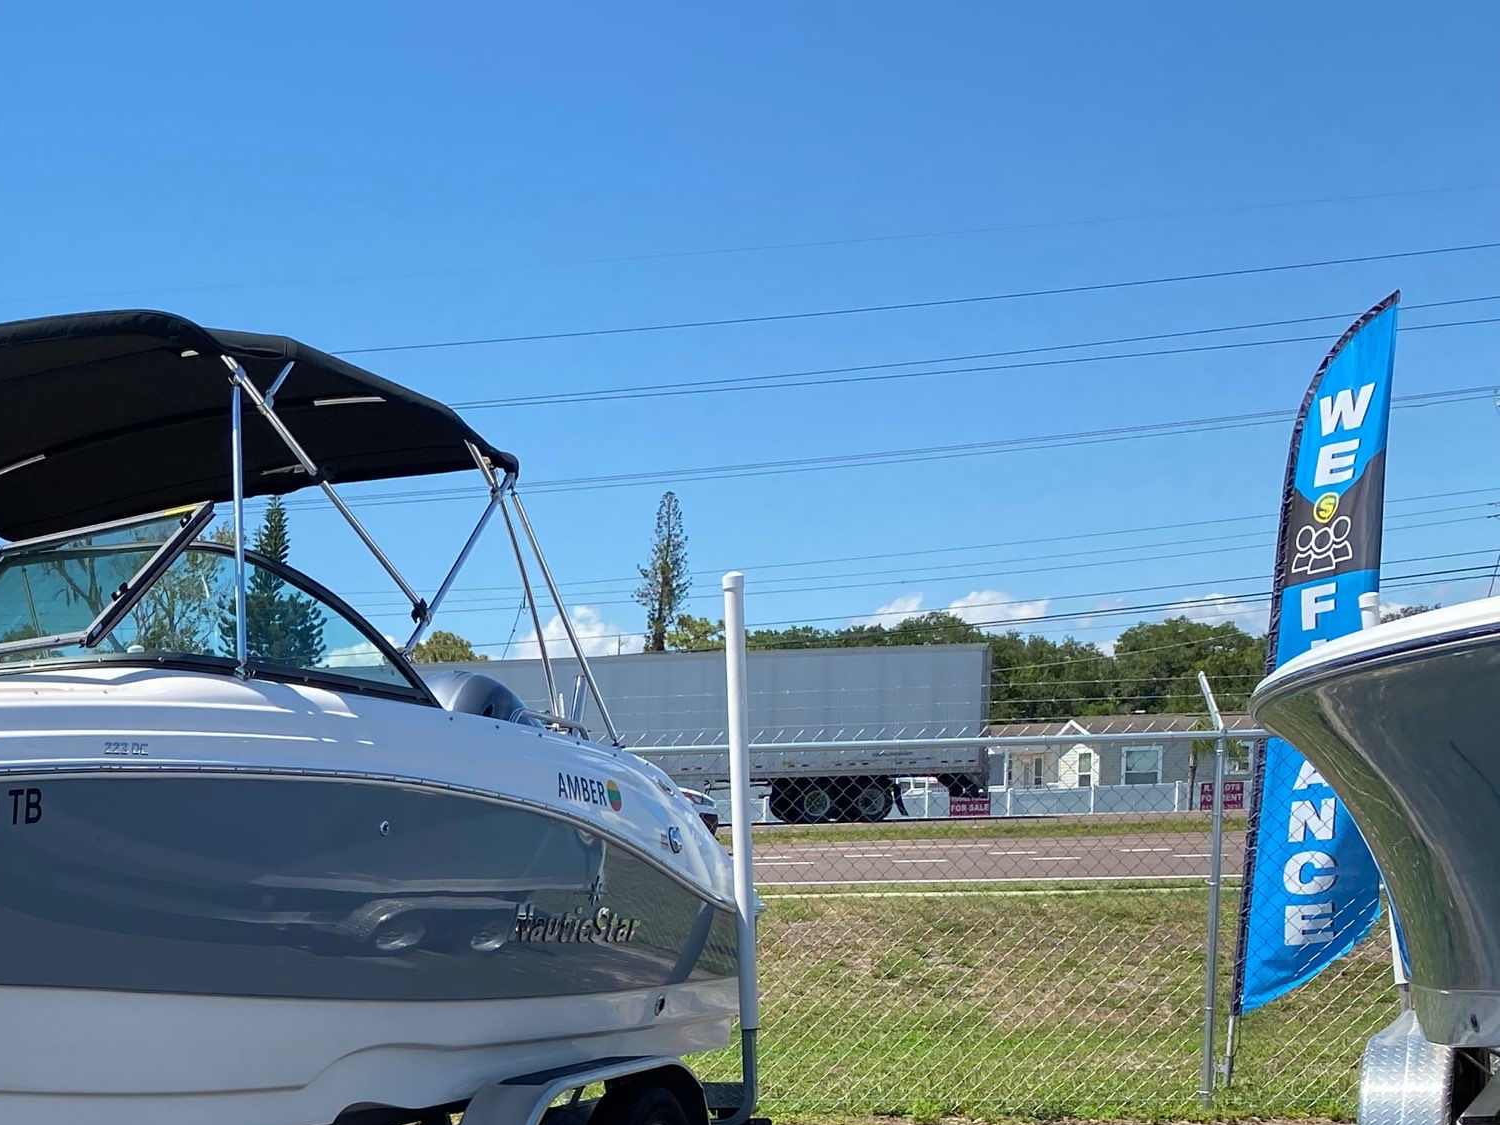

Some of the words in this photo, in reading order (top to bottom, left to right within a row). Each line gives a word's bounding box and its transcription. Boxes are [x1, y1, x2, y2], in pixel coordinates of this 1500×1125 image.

[1313, 381, 1376, 488] WE
[8, 788, 42, 826] TB
[558, 772, 607, 807] AMBER
[950, 804, 967, 812] FOR
[969, 803, 989, 811] SALE
